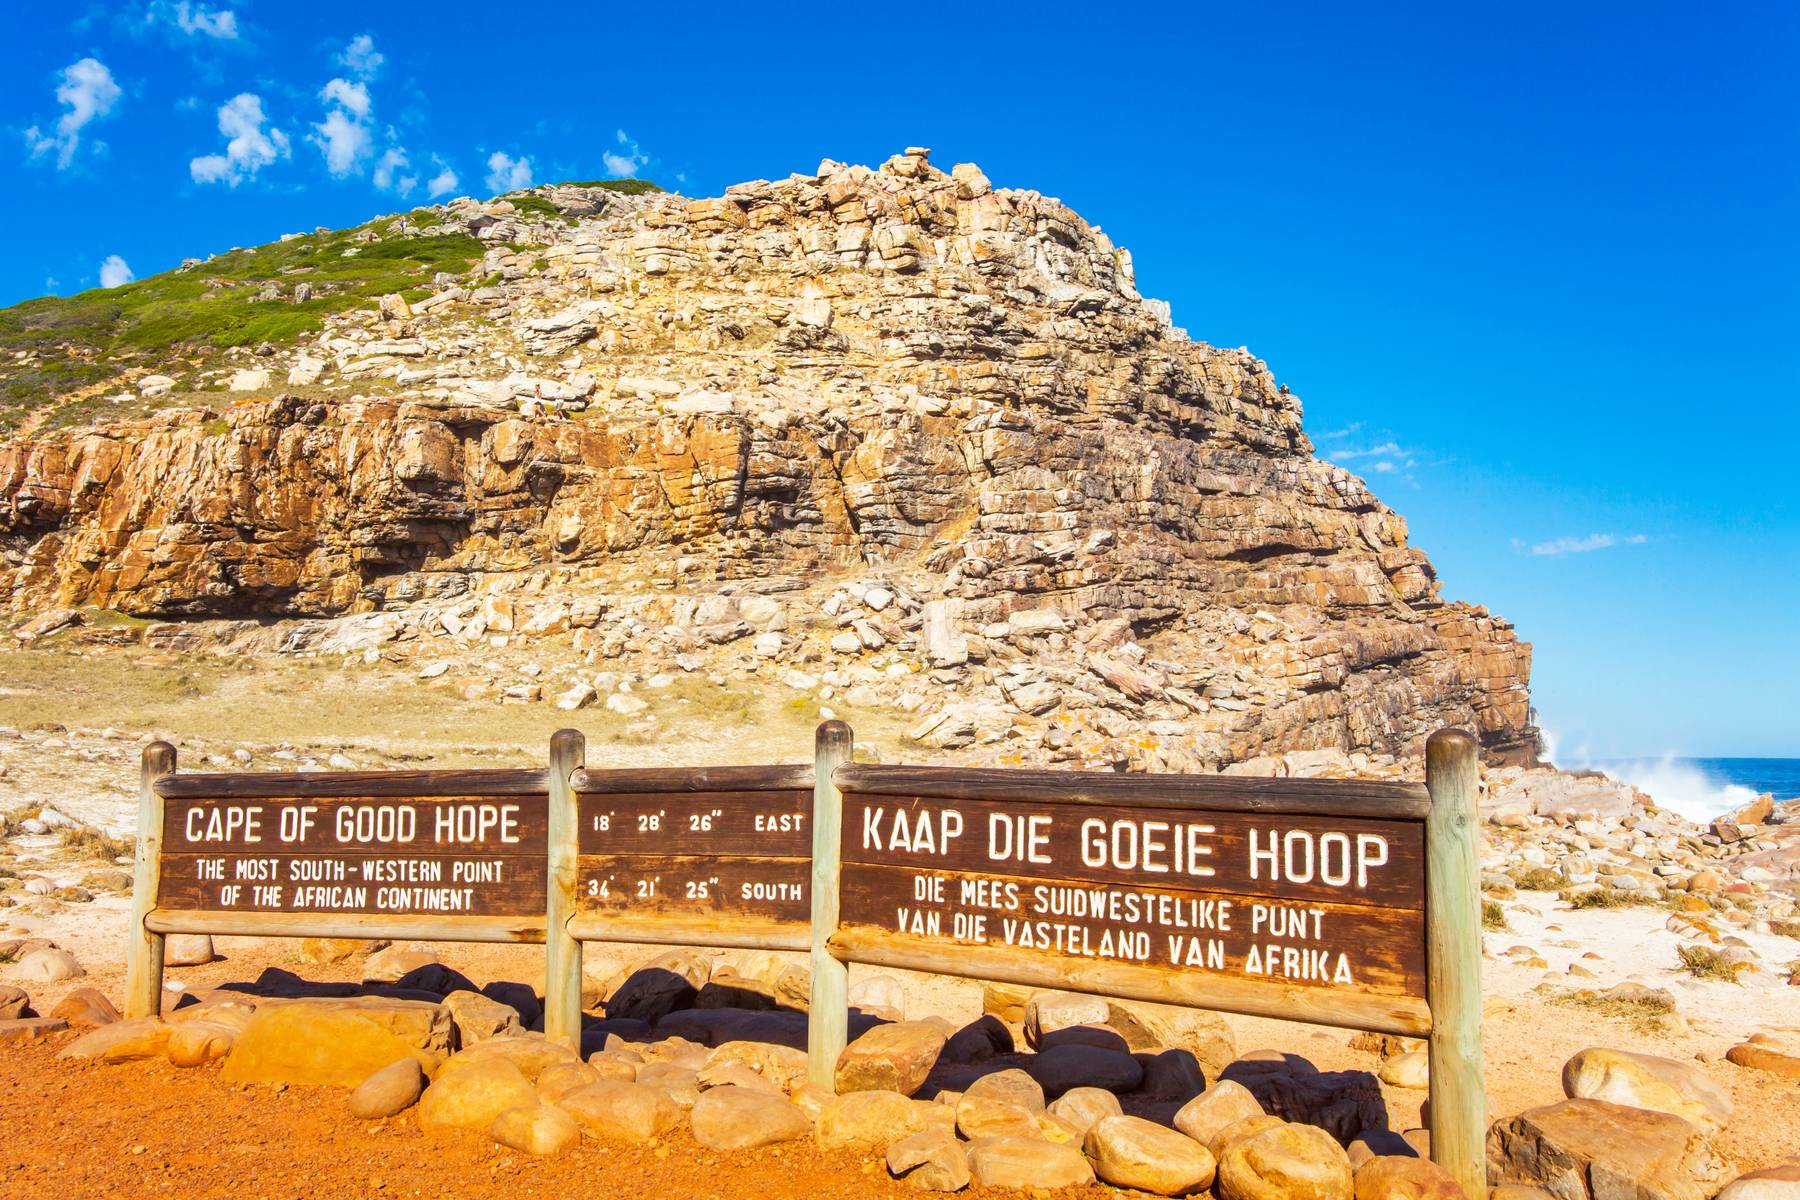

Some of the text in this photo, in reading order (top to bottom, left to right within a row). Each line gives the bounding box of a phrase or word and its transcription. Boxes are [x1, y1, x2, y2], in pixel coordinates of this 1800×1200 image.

[185, 804, 520, 844] CAPE OF GOOD HOPE
[754, 814, 804, 833] EAST
[862, 806, 1389, 889] KAAP DIE GOEIE HOOP
[195, 858, 226, 880] THE
[235, 858, 280, 881] MOST
[452, 860, 504, 884] POINT
[220, 884, 474, 911] OF THE AFRICAN CONTINENT
[741, 882, 802, 901] SOUTH
[914, 875, 1328, 941] DIE MEES SUIDWESTELIKE PUNT
[897, 907, 1353, 985] VAN DIE VASTELAND VAN AFRIKA
